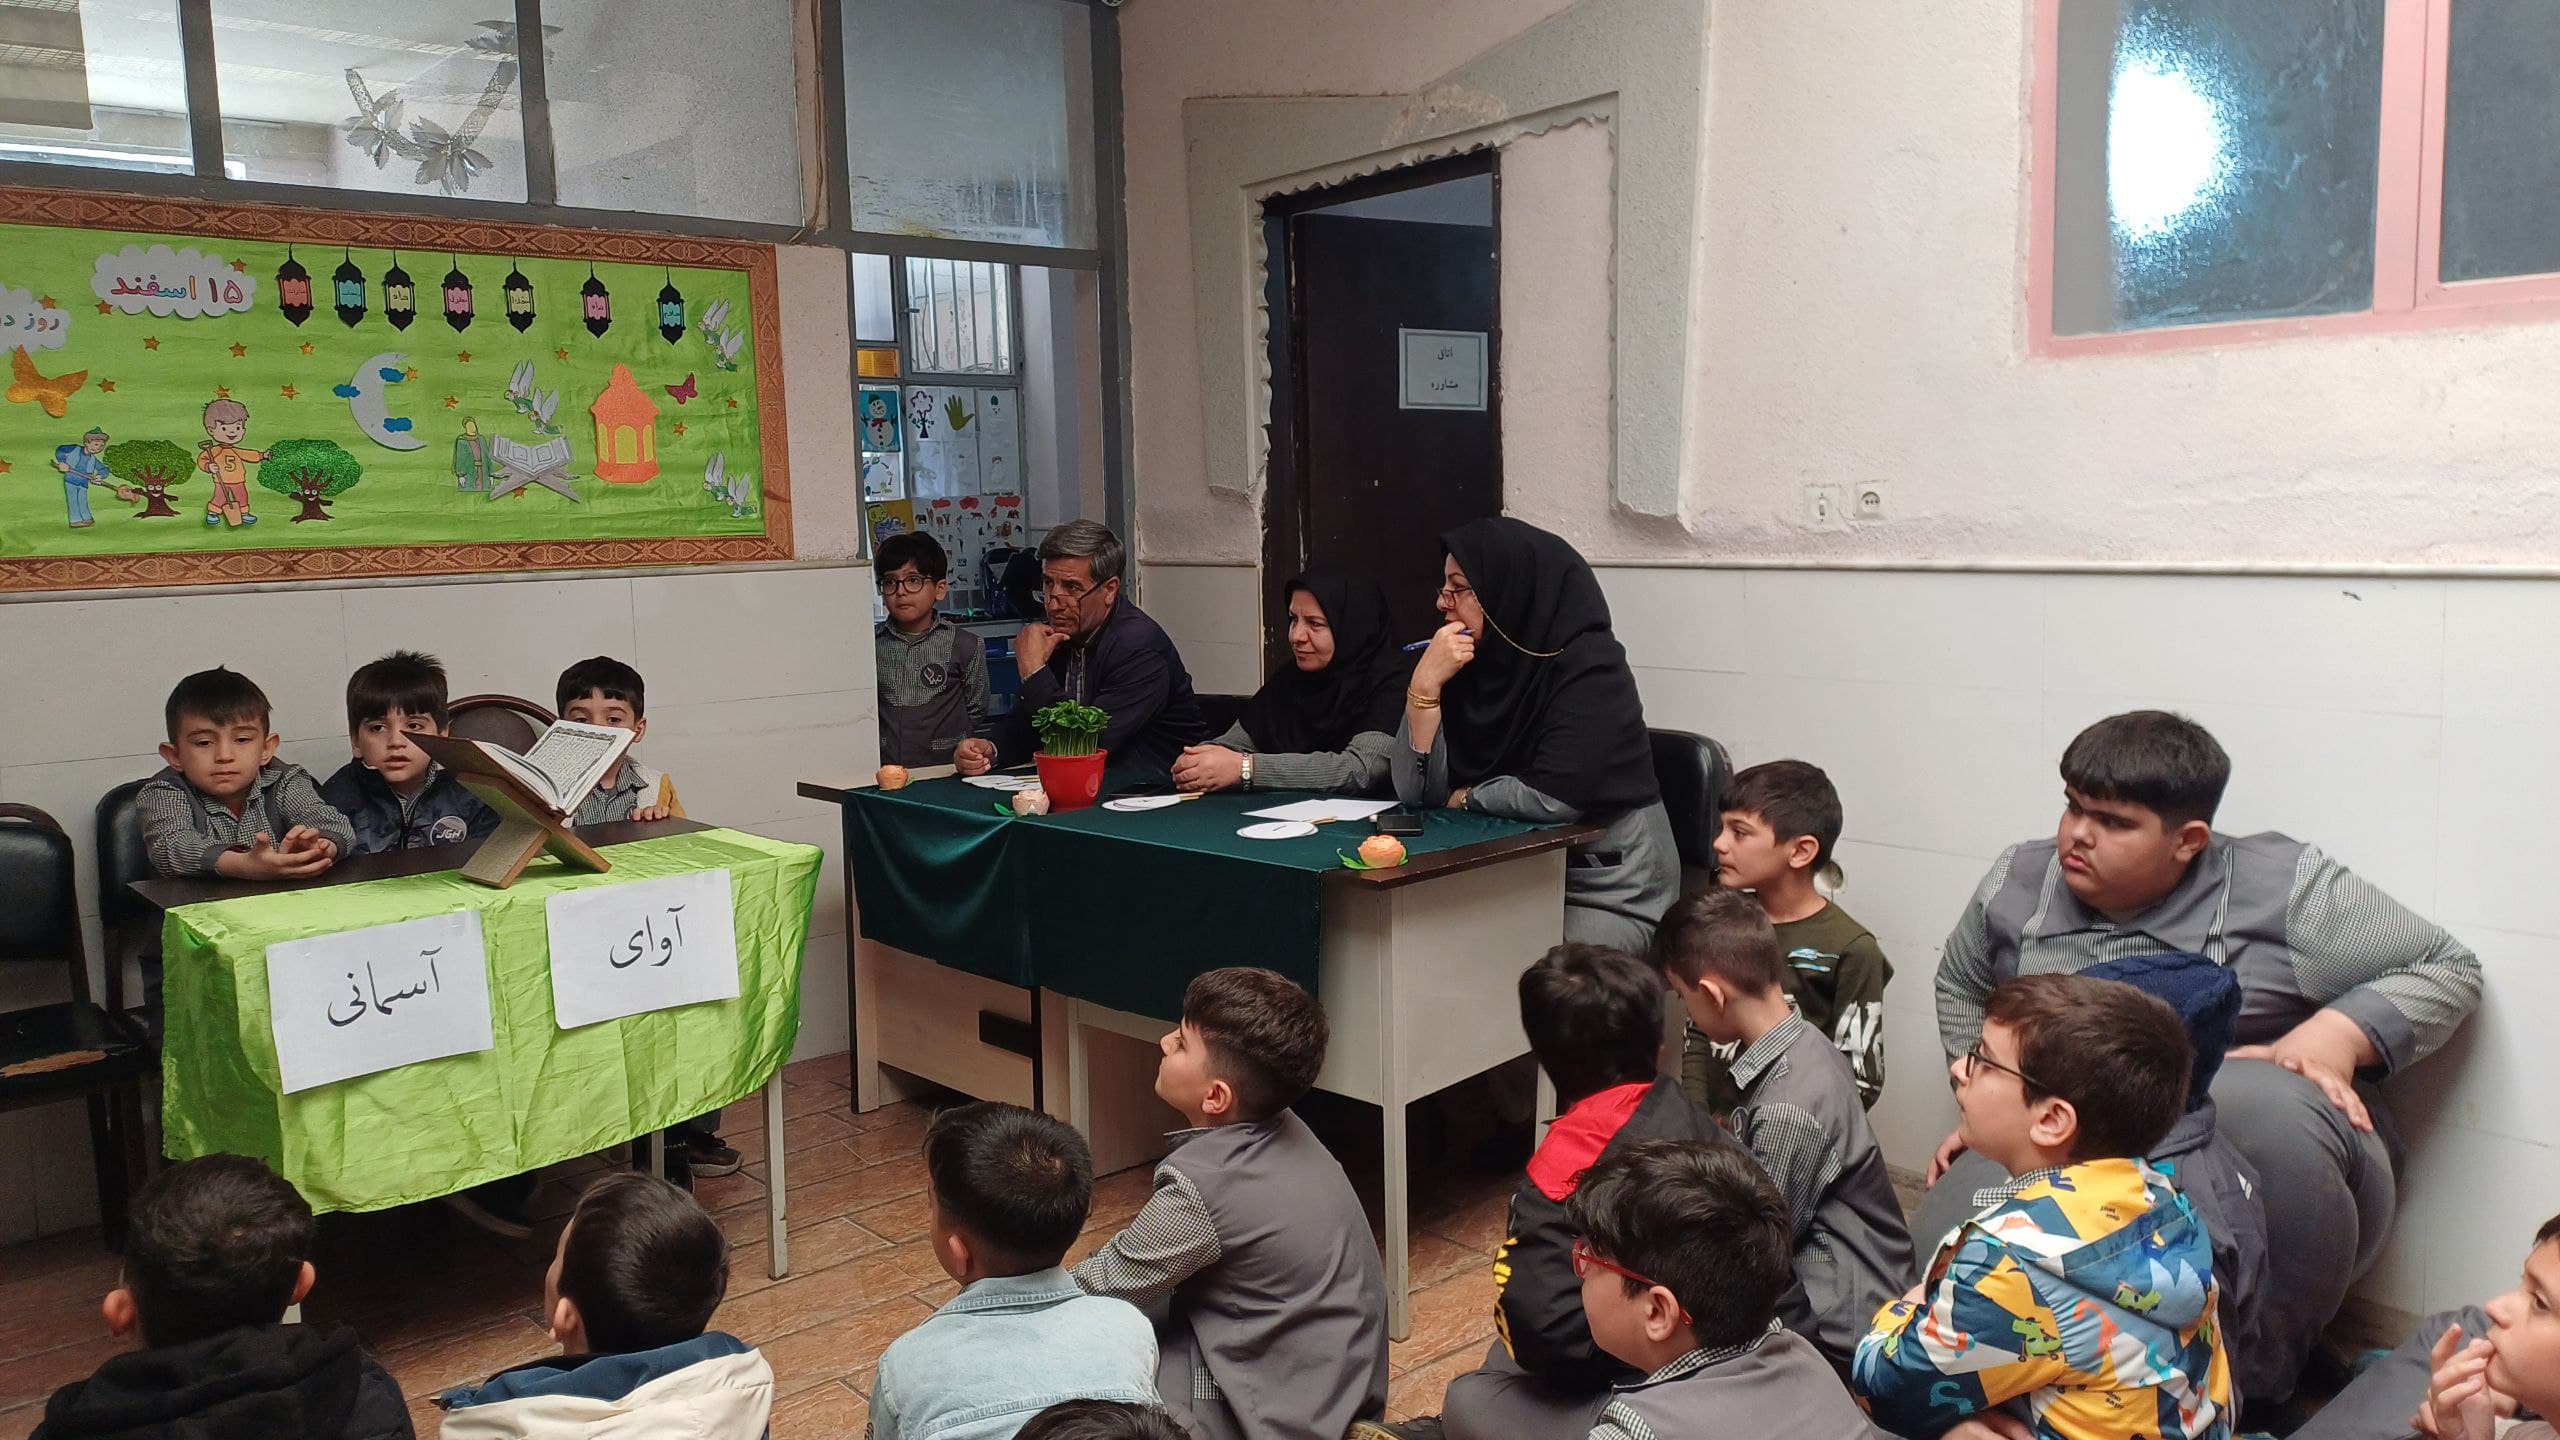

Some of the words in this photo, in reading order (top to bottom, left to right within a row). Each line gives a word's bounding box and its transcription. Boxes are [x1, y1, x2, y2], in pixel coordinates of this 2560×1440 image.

[110, 274, 197, 301] اسفند
[208, 277, 244, 304] ۱۵
[23, 312, 60, 333] روز
[224, 454, 237, 473] 5
[435, 829, 463, 840] JGH
[608, 903, 687, 970] آوای
[327, 945, 443, 1027] آسمانی
